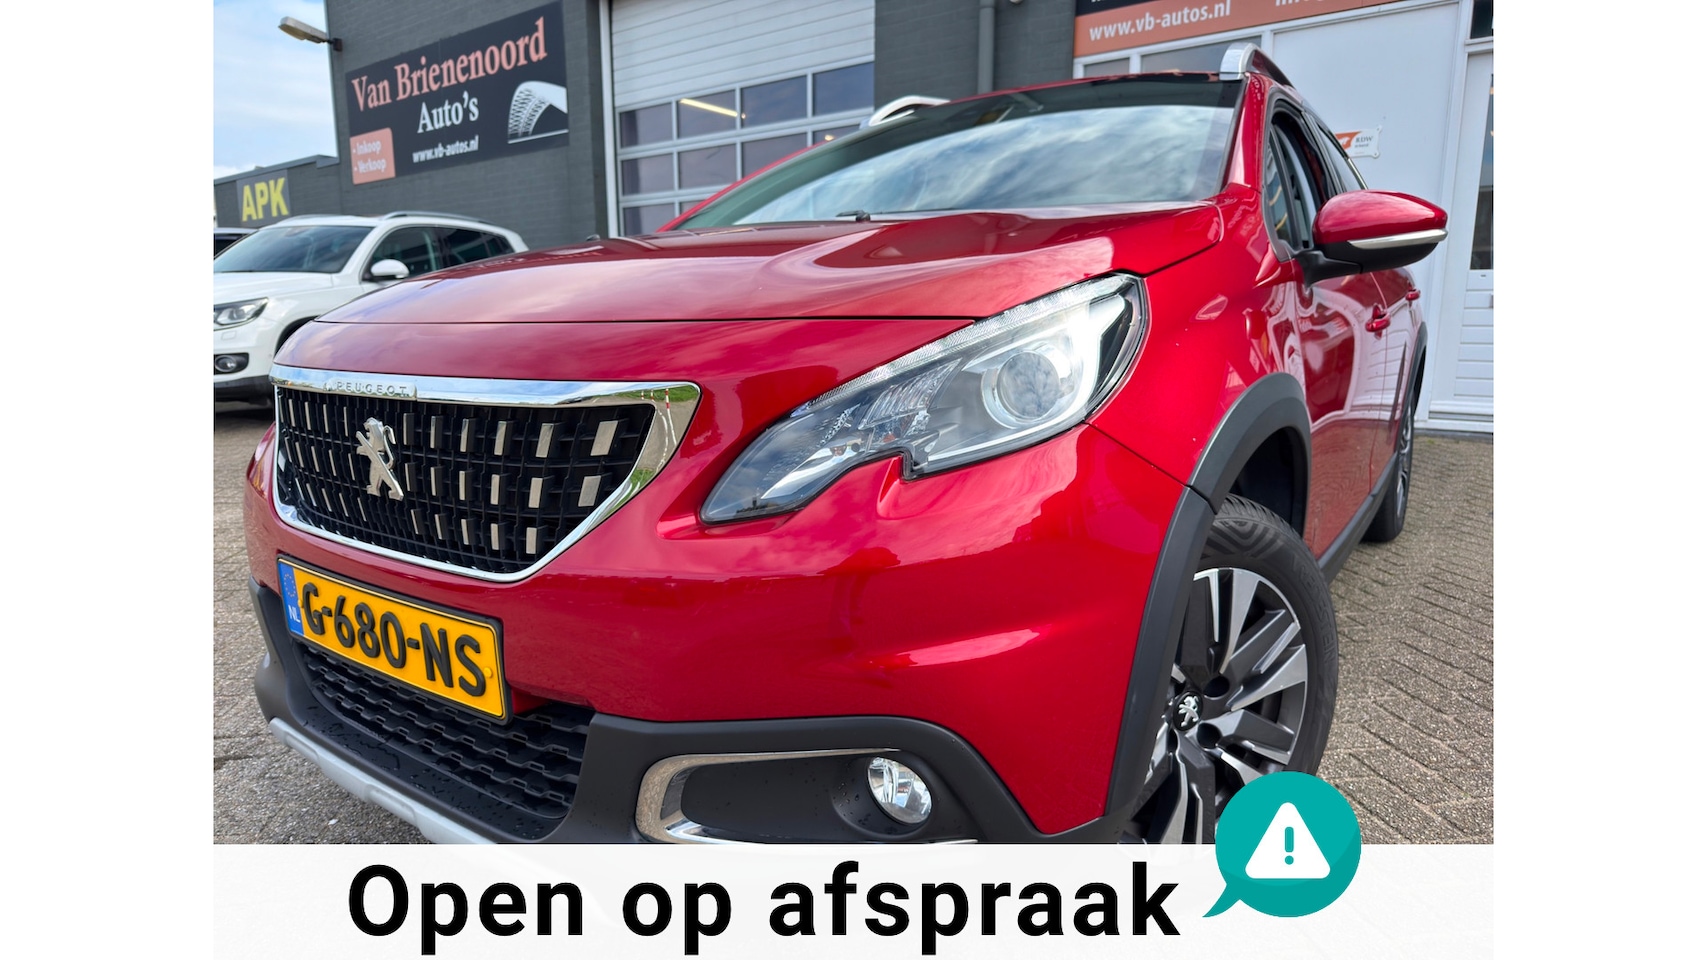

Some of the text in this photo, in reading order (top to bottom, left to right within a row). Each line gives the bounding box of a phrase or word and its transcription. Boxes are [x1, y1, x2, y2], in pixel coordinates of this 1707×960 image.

[1089, 0, 1231, 42] www.vb-autos.nl
[351, 16, 548, 112] Van Brienenoord
[417, 90, 479, 133] Auto's
[356, 140, 382, 155] Inkoop
[412, 135, 479, 163] www.vb-autos.nl
[357, 158, 387, 173] Verkoop
[242, 177, 289, 222] APK
[336, 381, 407, 397] PEUGEOT
[288, 604, 301, 623] NL
[302, 582, 486, 697] G-680-NS
